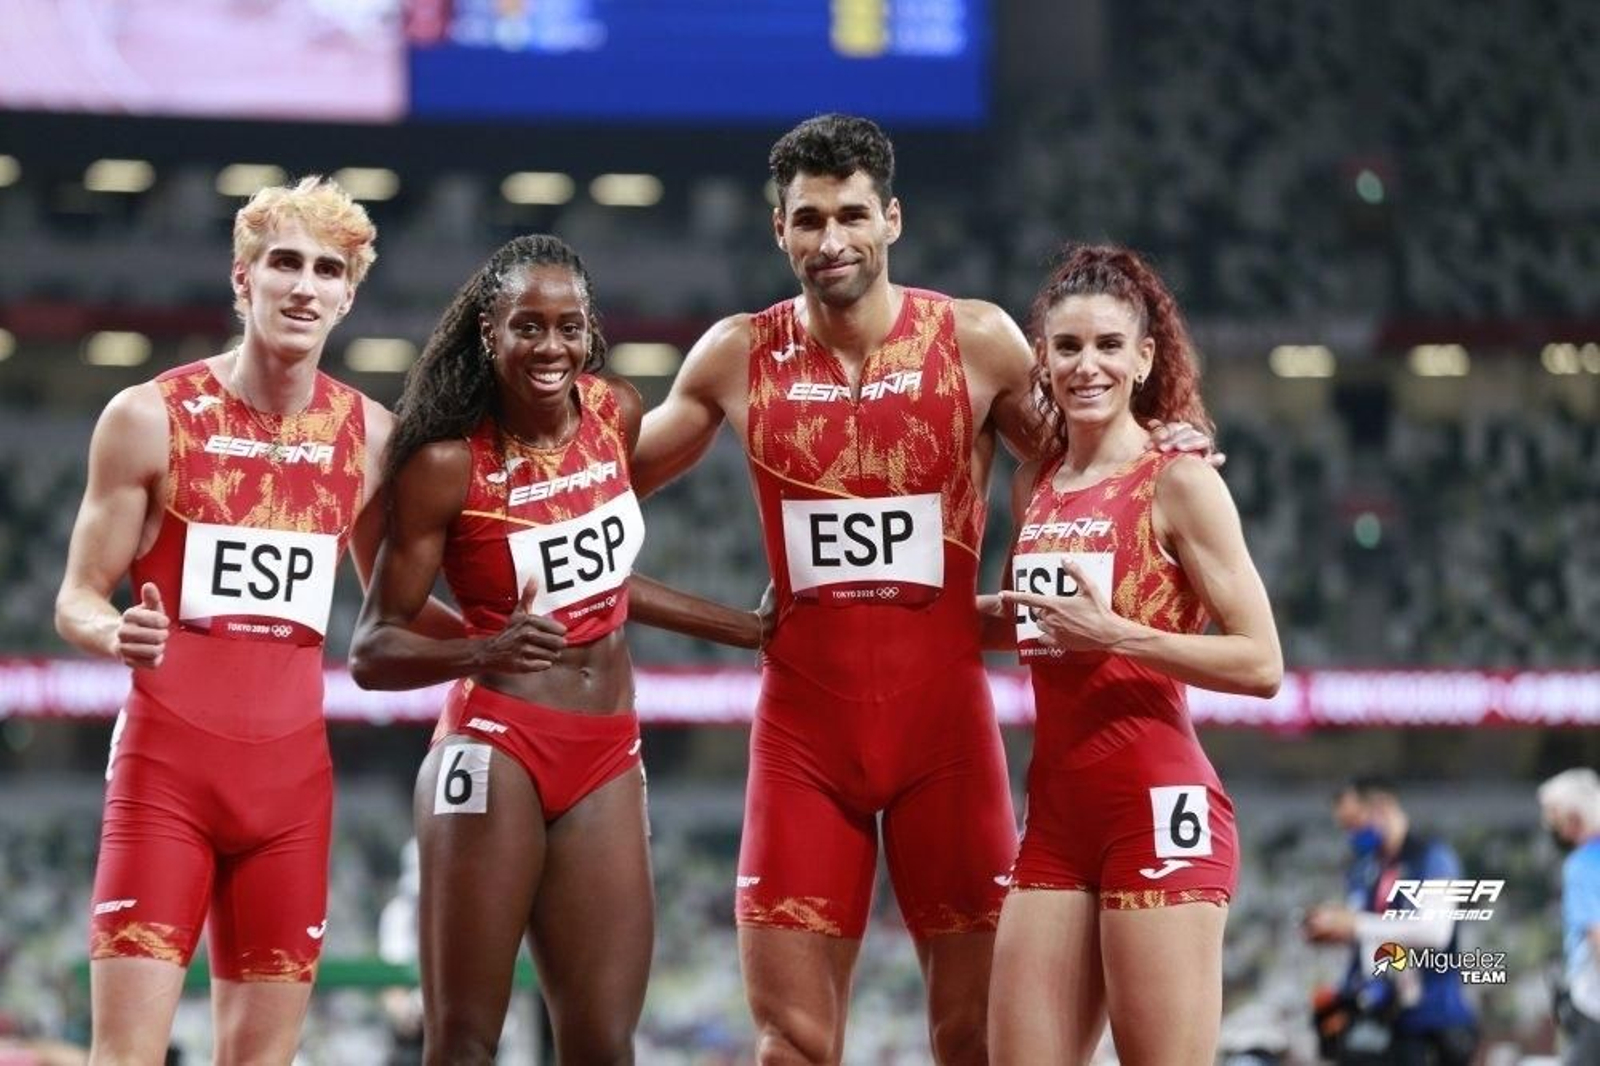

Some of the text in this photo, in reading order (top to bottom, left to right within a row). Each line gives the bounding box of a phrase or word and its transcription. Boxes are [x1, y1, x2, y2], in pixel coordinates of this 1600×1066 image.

[786, 371, 923, 402] ESPAÑA
[508, 461, 617, 507] ESPAÑA
[539, 516, 624, 593] ESP
[810, 510, 913, 567] ESP
[1019, 517, 1114, 543] SPAÑA
[211, 540, 314, 602] ESP
[466, 717, 509, 734] ESP
[445, 751, 472, 805] 6
[1170, 793, 1202, 848] 6
[94, 900, 137, 914] ESP
